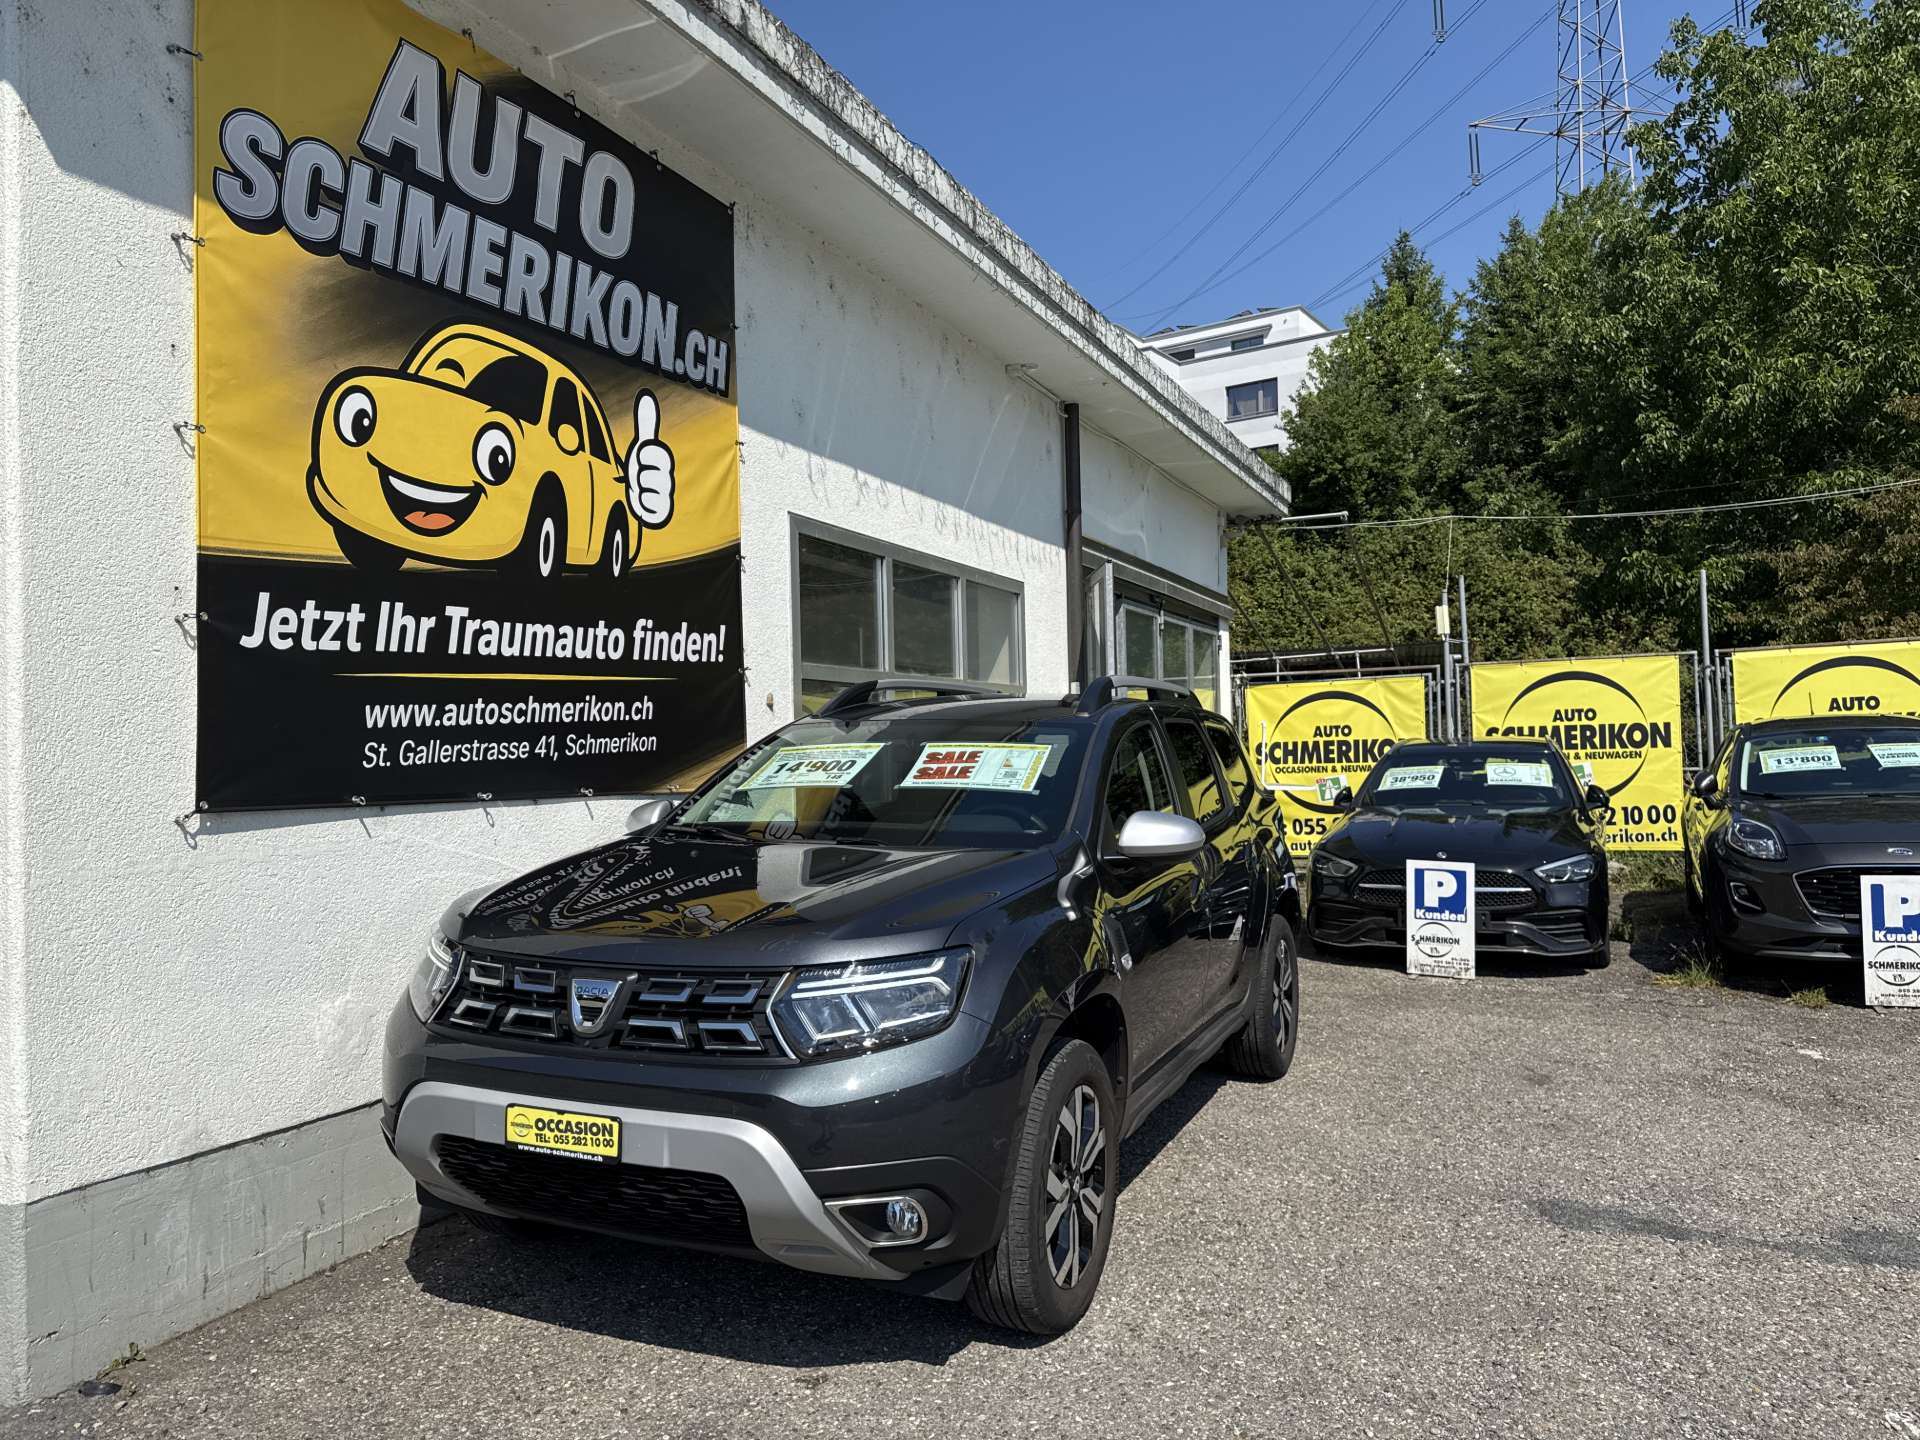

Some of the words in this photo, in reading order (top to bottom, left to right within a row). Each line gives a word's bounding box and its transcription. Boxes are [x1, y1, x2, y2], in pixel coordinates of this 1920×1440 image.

[359, 38, 635, 260] AUTO
[215, 110, 729, 393] SCHMERIKON.CH
[239, 592, 365, 652] Jetzt
[375, 600, 436, 654] Ihr
[444, 605, 625, 661] Traumauto
[632, 618, 726, 663] finden!
[364, 695, 654, 729] www.autoschmerikon.ch
[1828, 695, 1881, 712] AUTO
[1552, 708, 1597, 722] AUTO
[1313, 725, 1352, 738] AUTO
[362, 741, 392, 769] St.
[399, 736, 530, 767] Gallerstrasse
[535, 736, 559, 762] 41,
[565, 732, 657, 758] Schmerikon
[923, 750, 985, 765] SALE
[1255, 738, 1406, 767] SCHMERIKO
[1574, 752, 1582, 760] &
[1585, 750, 1642, 761] NEUWAGEN
[1275, 764, 1328, 774] OCCASIONEN
[1331, 764, 1338, 774] &
[1341, 763, 1374, 773] NEUWA
[1774, 754, 1833, 766] 13'800
[913, 766, 976, 780] SALE
[1390, 774, 1435, 785] 38'950
[1622, 806, 1644, 825] 10
[1647, 804, 1677, 825] 00
[1292, 817, 1328, 836] 055
[1605, 827, 1678, 844] erikon.ch
[1424, 870, 1457, 908] P
[1415, 908, 1466, 922] Kunden
[1874, 930, 1920, 942] Kund
[576, 985, 609, 995] DACIA
[534, 1117, 614, 1137] OCCASION
[534, 1132, 551, 1144] TEL:
[553, 1134, 570, 1145] 055
[571, 1135, 588, 1147] 282
[590, 1137, 601, 1148] 10
[602, 1138, 615, 1149] 00
[517, 1143, 604, 1162] www.auto-schmerikon.ch
